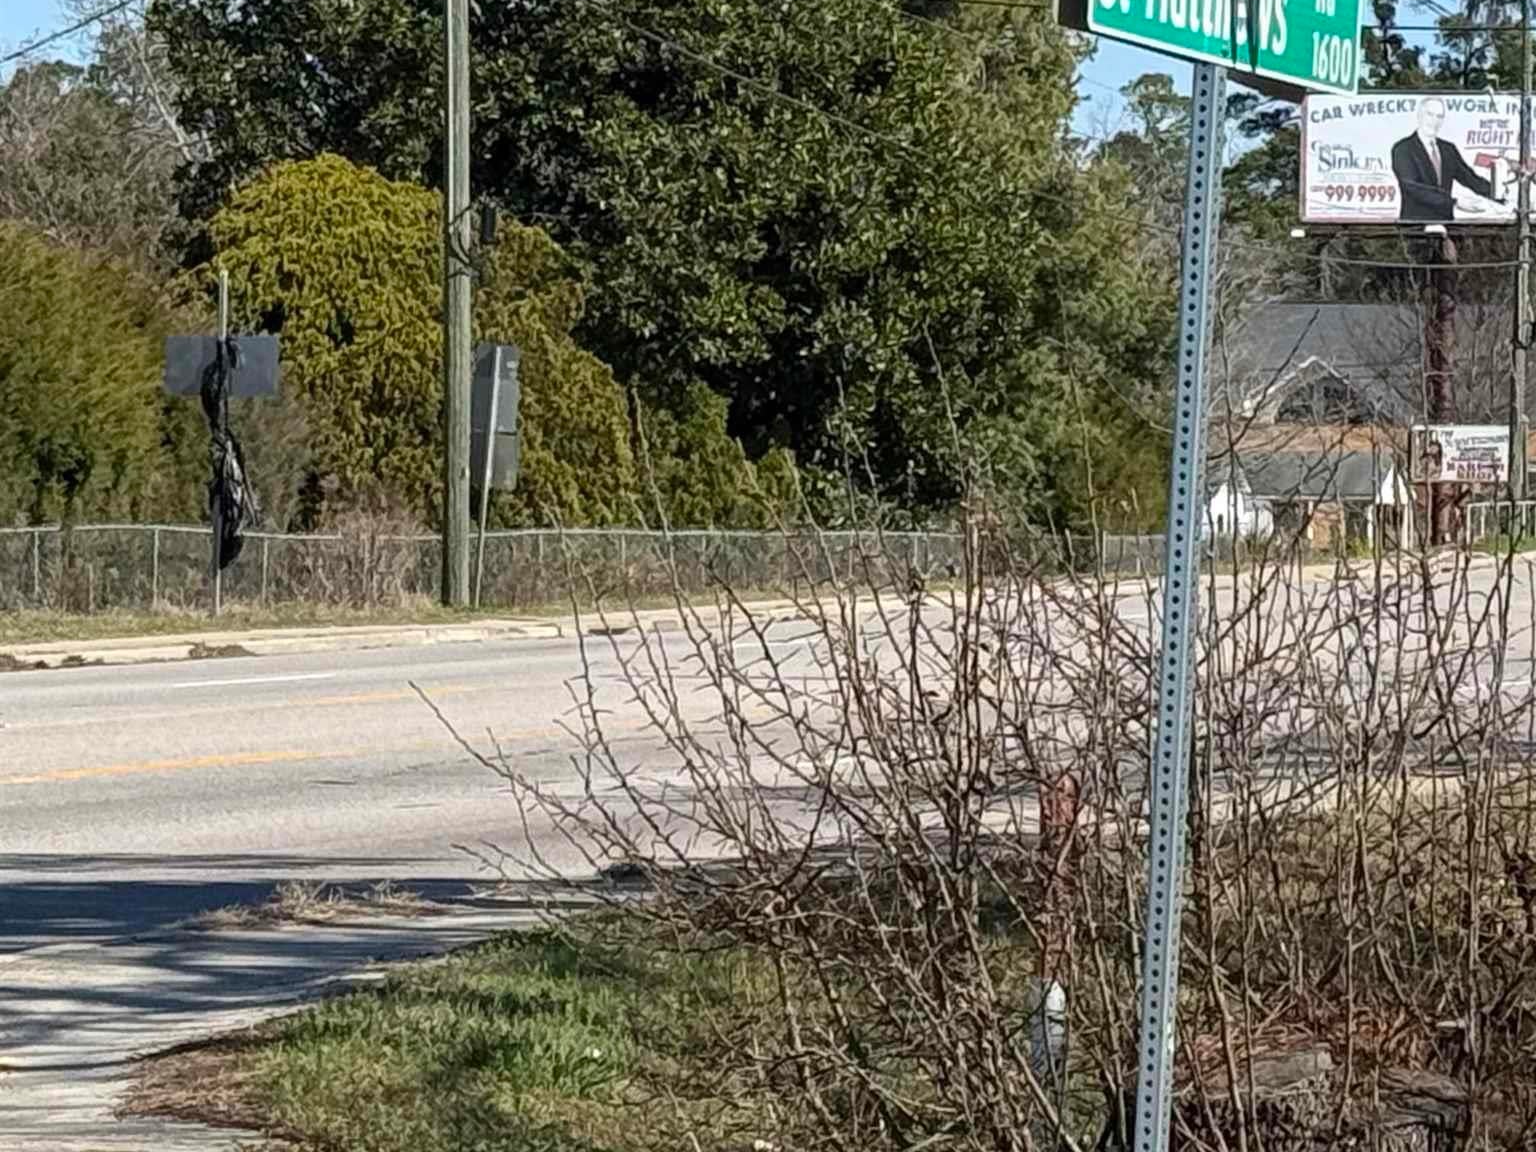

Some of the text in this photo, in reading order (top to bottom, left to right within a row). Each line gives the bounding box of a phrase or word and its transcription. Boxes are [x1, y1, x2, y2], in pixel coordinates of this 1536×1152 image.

[1312, 31, 1352, 86] 1600
[1310, 105, 1343, 124] CAR
[1349, 98, 1417, 117] WRECK?
[1446, 98, 1499, 114] WORK
[1466, 129, 1514, 146] RIGHT
